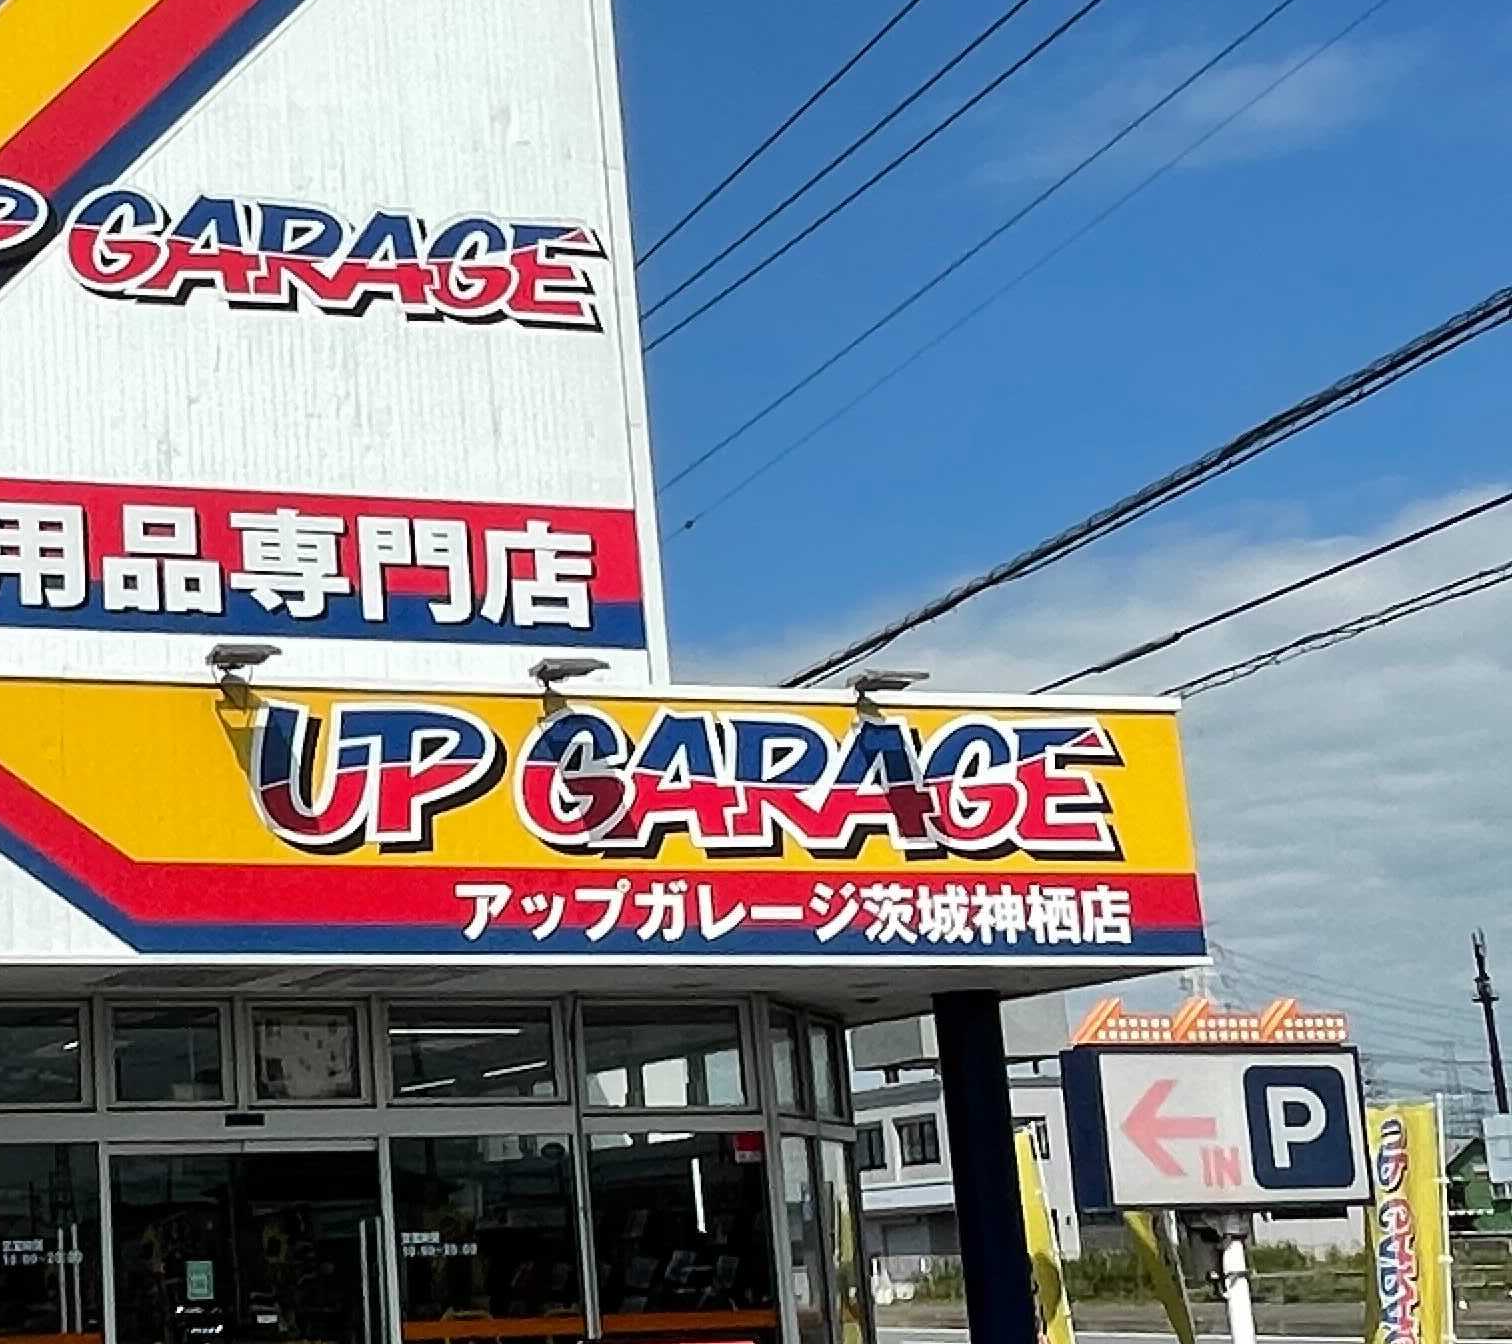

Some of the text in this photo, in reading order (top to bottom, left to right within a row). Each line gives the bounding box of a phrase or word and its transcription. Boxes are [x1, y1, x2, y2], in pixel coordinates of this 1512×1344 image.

[64, 187, 608, 330] GARAGE
[250, 700, 1126, 861] UP GARAGE
[453, 877, 1133, 947] アップガレージ茨城神栖店
[1200, 1146, 1243, 1188] IN
[1266, 1086, 1326, 1168] P
